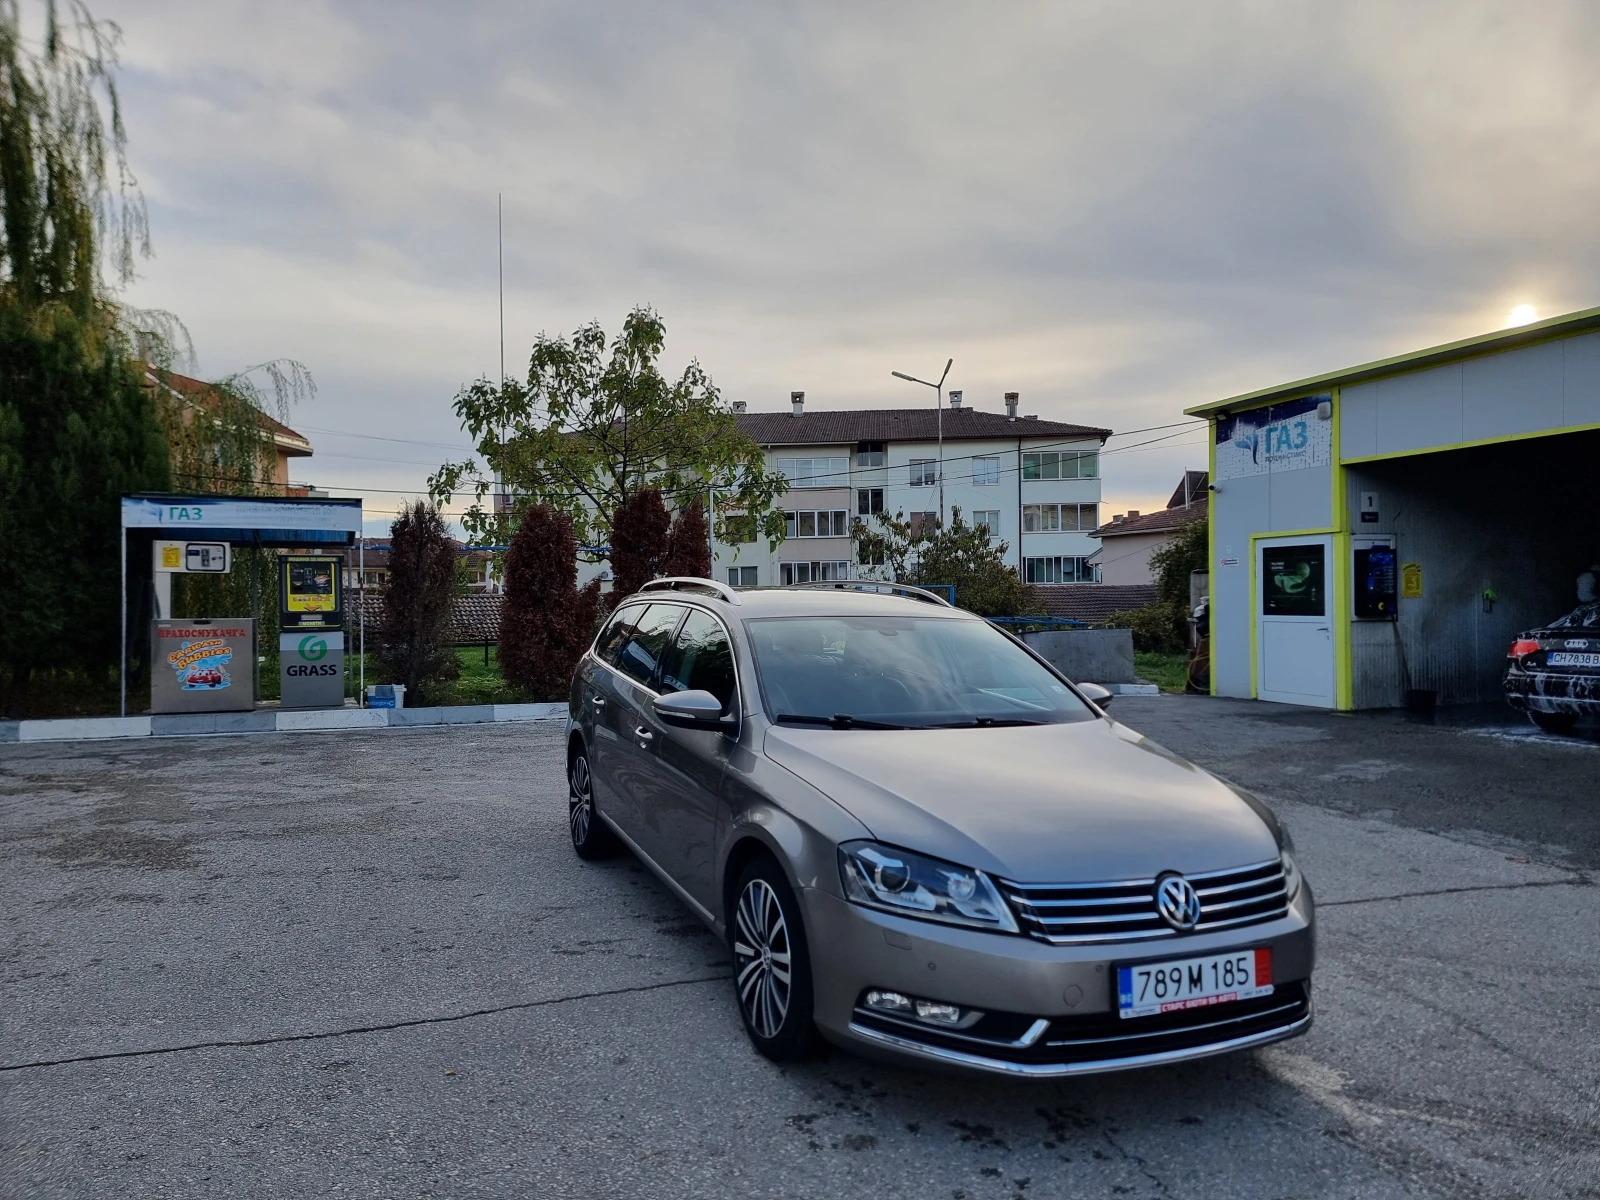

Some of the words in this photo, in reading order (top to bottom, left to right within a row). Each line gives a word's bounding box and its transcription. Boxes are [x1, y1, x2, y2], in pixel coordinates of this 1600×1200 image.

[1264, 421, 1308, 454] ГАЗ
[1367, 496, 1373, 507] 1
[169, 507, 203, 521] ГАЗ
[157, 628, 246, 639] ПРАХОСМУКАЧКА
[1554, 654, 1567, 662] CH
[1568, 654, 1591, 664] 7838
[286, 664, 337, 677] GRASS
[1138, 967, 1182, 1002] 789
[1188, 964, 1203, 994] M
[1211, 957, 1249, 990] 185
